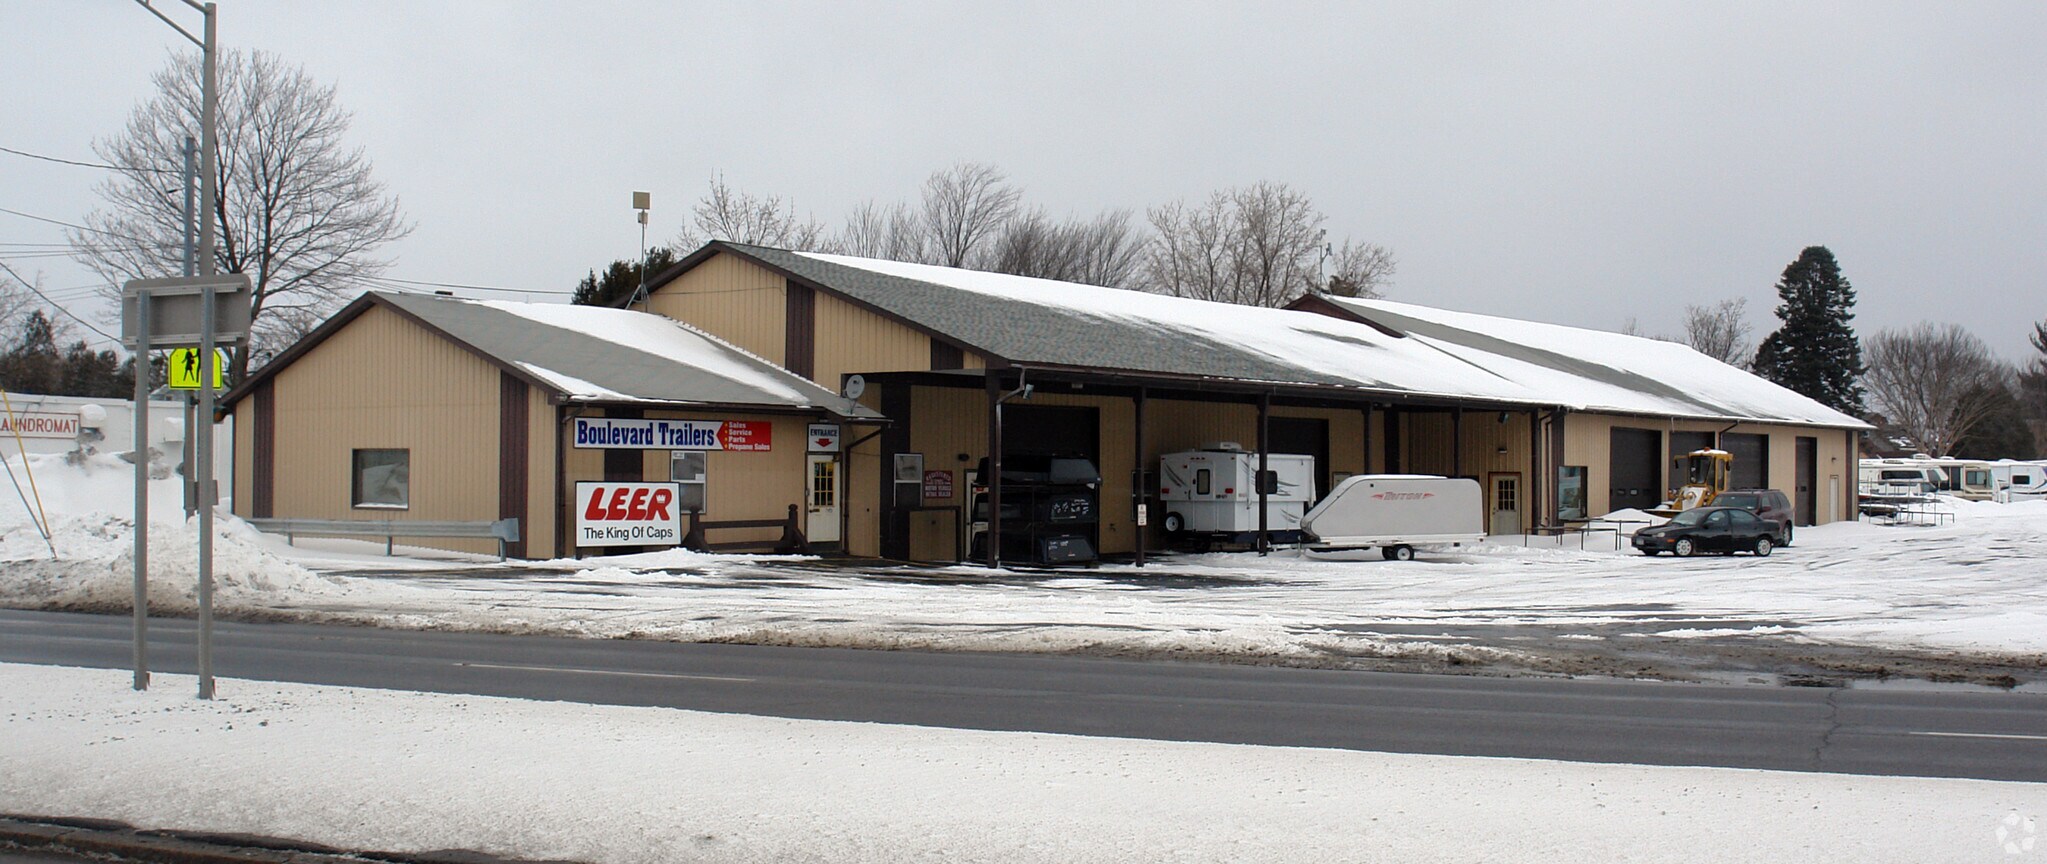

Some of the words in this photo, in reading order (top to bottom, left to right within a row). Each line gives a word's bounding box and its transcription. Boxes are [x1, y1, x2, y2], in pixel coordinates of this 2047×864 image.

[0, 418, 77, 433] AUNDROMAT
[577, 420, 654, 445] Boulevard
[658, 422, 714, 446] Trailers
[810, 428, 837, 437] ENTRANCE
[585, 487, 672, 521] LEER
[584, 527, 604, 539] The
[606, 527, 629, 541] King
[632, 526, 645, 538] Of
[646, 526, 673, 540] Caps
